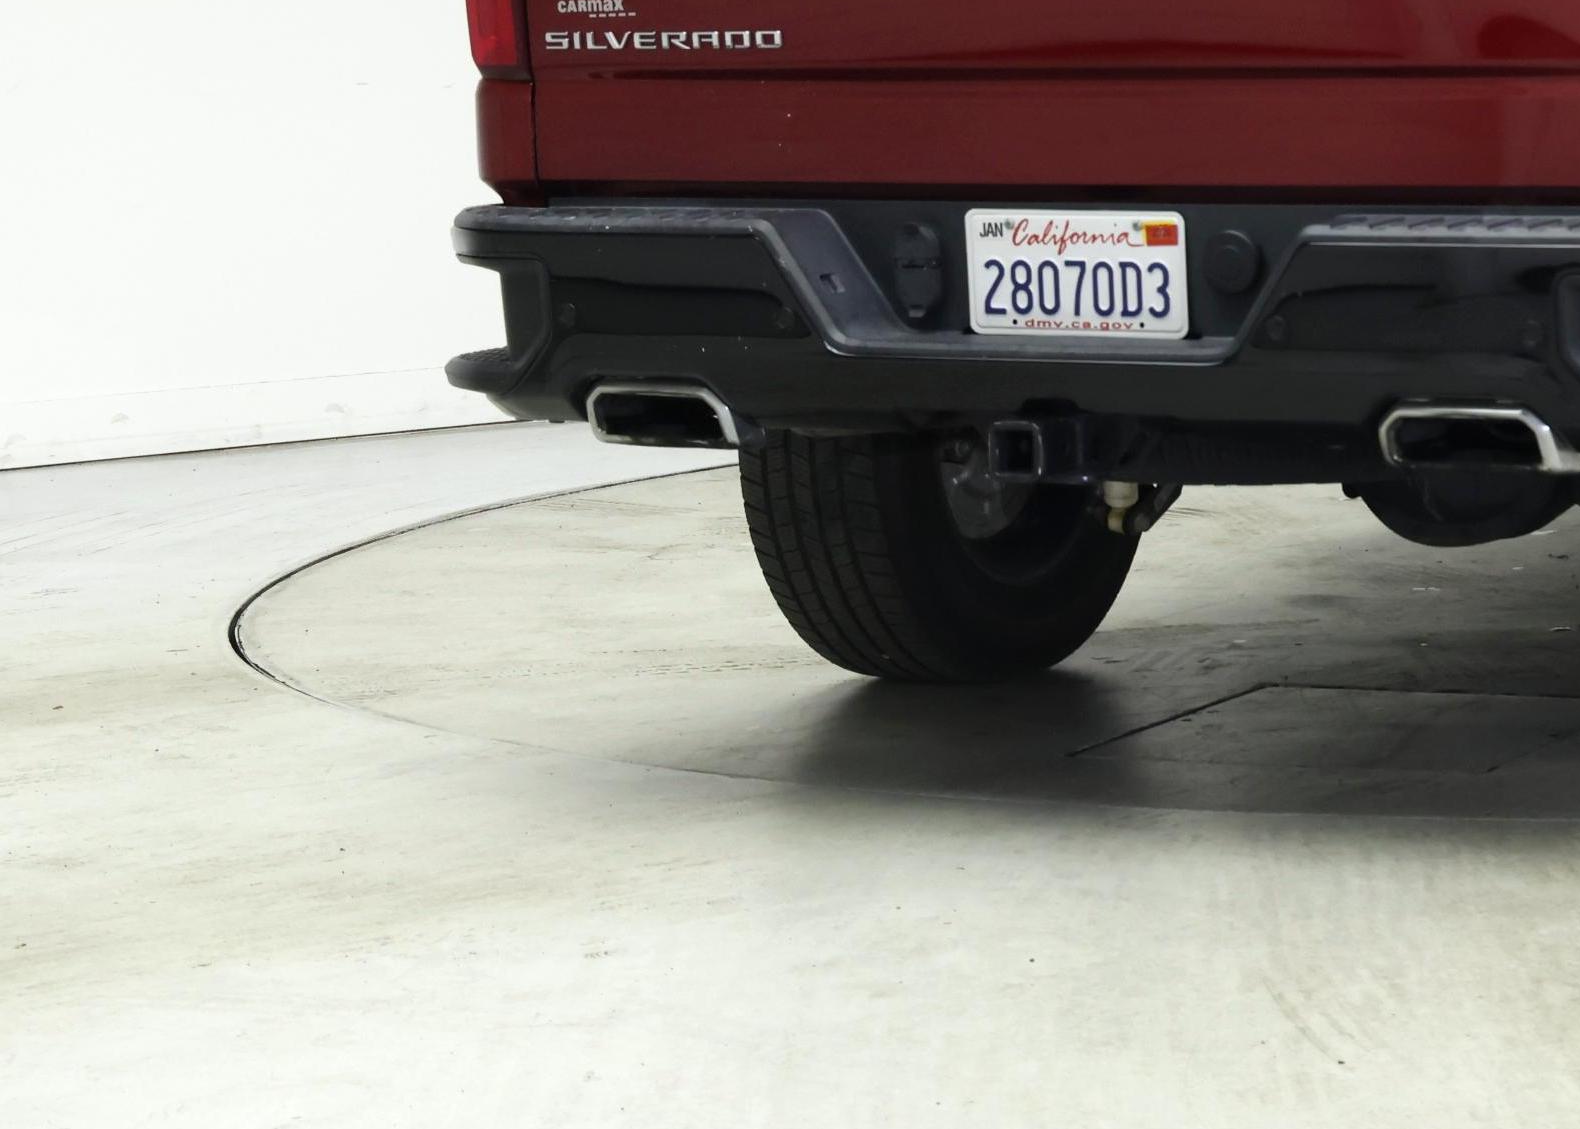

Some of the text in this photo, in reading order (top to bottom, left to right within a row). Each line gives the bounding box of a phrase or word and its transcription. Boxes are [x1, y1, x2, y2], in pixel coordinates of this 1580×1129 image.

[545, 29, 782, 50] SILVERADO
[979, 222, 1003, 238] JAN
[1012, 218, 1144, 255] California
[984, 259, 1171, 319] 28070D3
[1024, 318, 1134, 331] dmv.ca.gov
